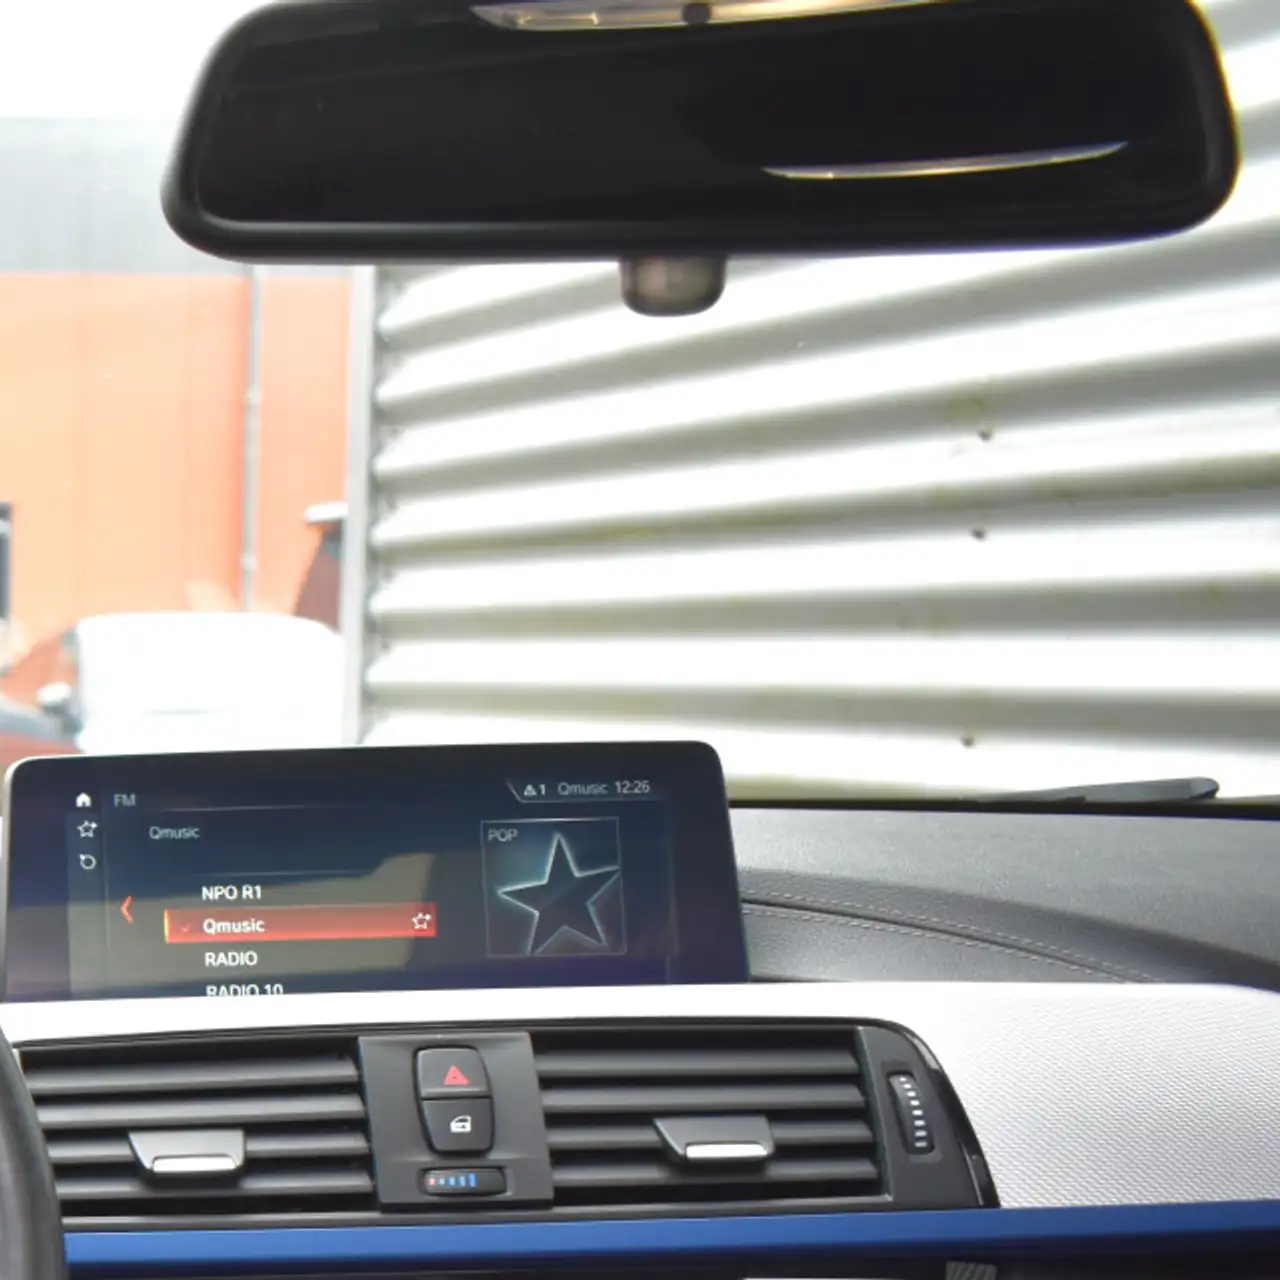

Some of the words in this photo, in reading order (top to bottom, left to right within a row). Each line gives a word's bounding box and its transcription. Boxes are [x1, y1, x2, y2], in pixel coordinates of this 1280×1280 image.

[557, 782, 608, 796] Qmusic
[113, 793, 137, 807] FM
[149, 826, 200, 840] Qmusic
[487, 827, 519, 843] POP
[201, 885, 238, 900] NPO
[242, 884, 262, 899] R1
[202, 918, 266, 935] Qmusic
[205, 951, 258, 967] RADIO
[206, 984, 260, 998] RADIO
[264, 983, 284, 996] 10
